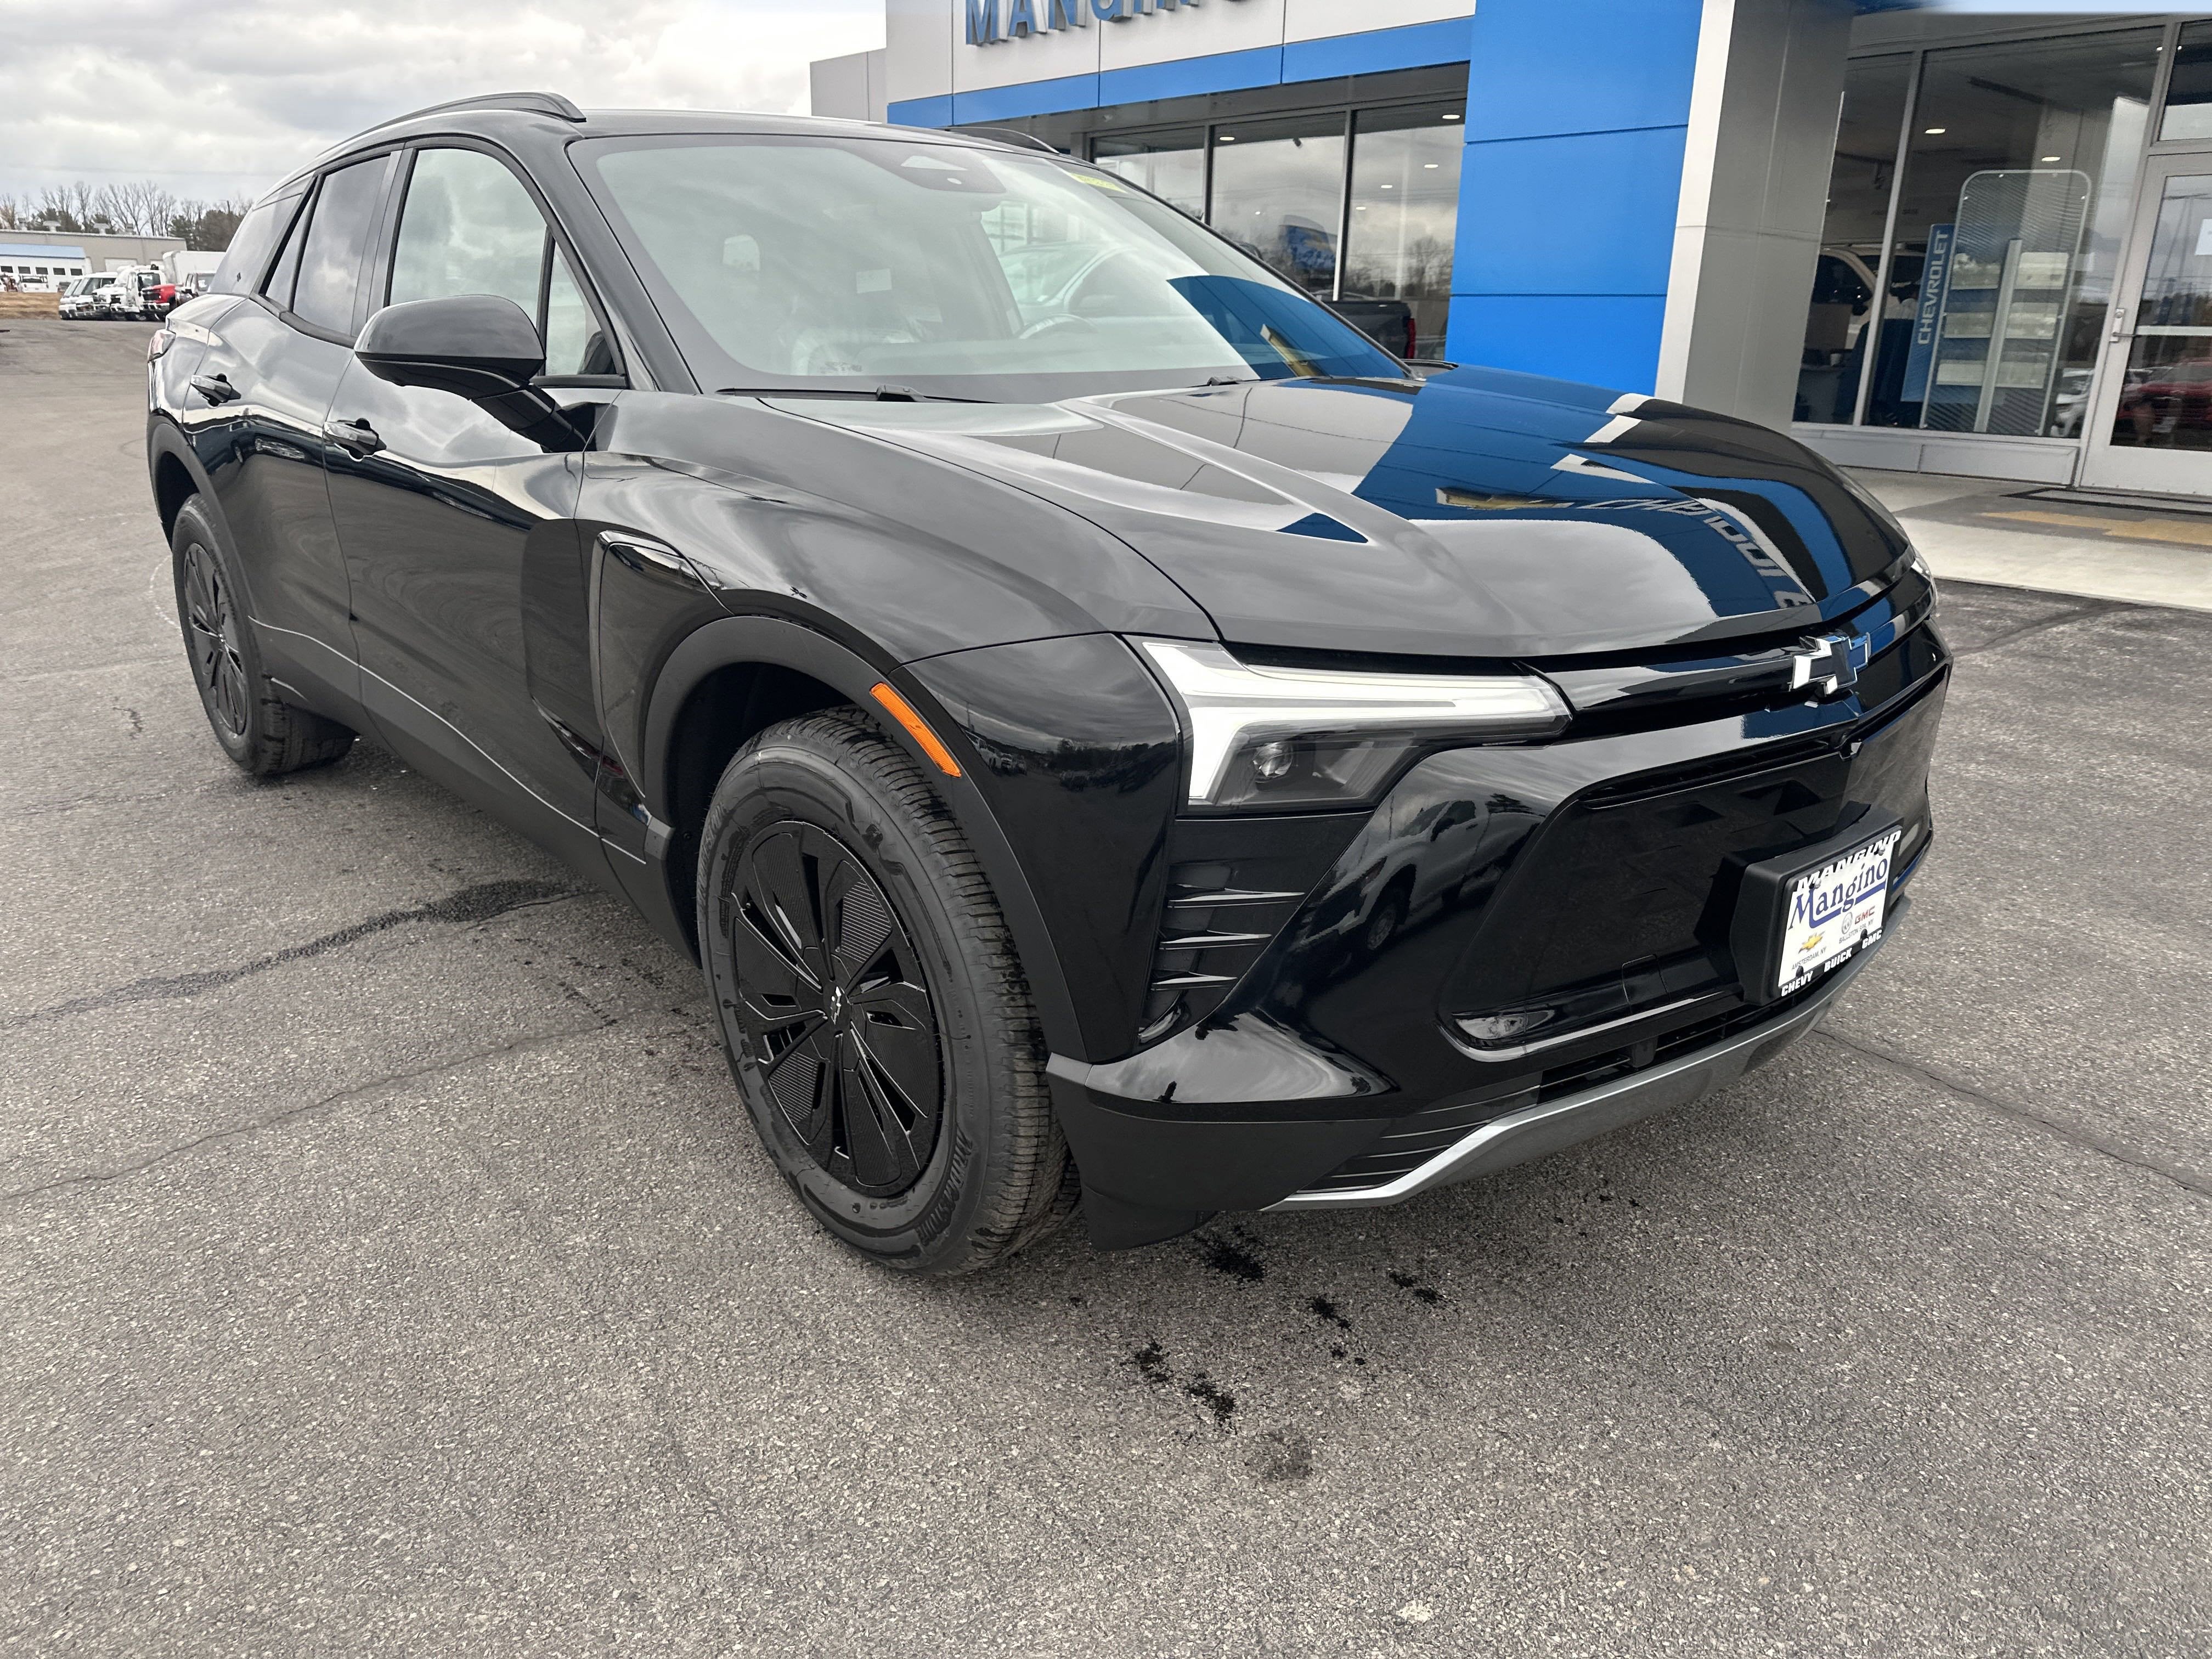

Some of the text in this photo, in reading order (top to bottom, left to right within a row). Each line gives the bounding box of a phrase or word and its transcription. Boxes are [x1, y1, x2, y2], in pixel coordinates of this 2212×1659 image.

[1917, 230, 1948, 344] CHEVROLET
[1788, 859, 1888, 930] Mangino
[1797, 830, 1901, 893] MANGINO
[1855, 905, 1875, 924] GMC
[1781, 929, 1882, 996] CHEVY BUICK GMC
